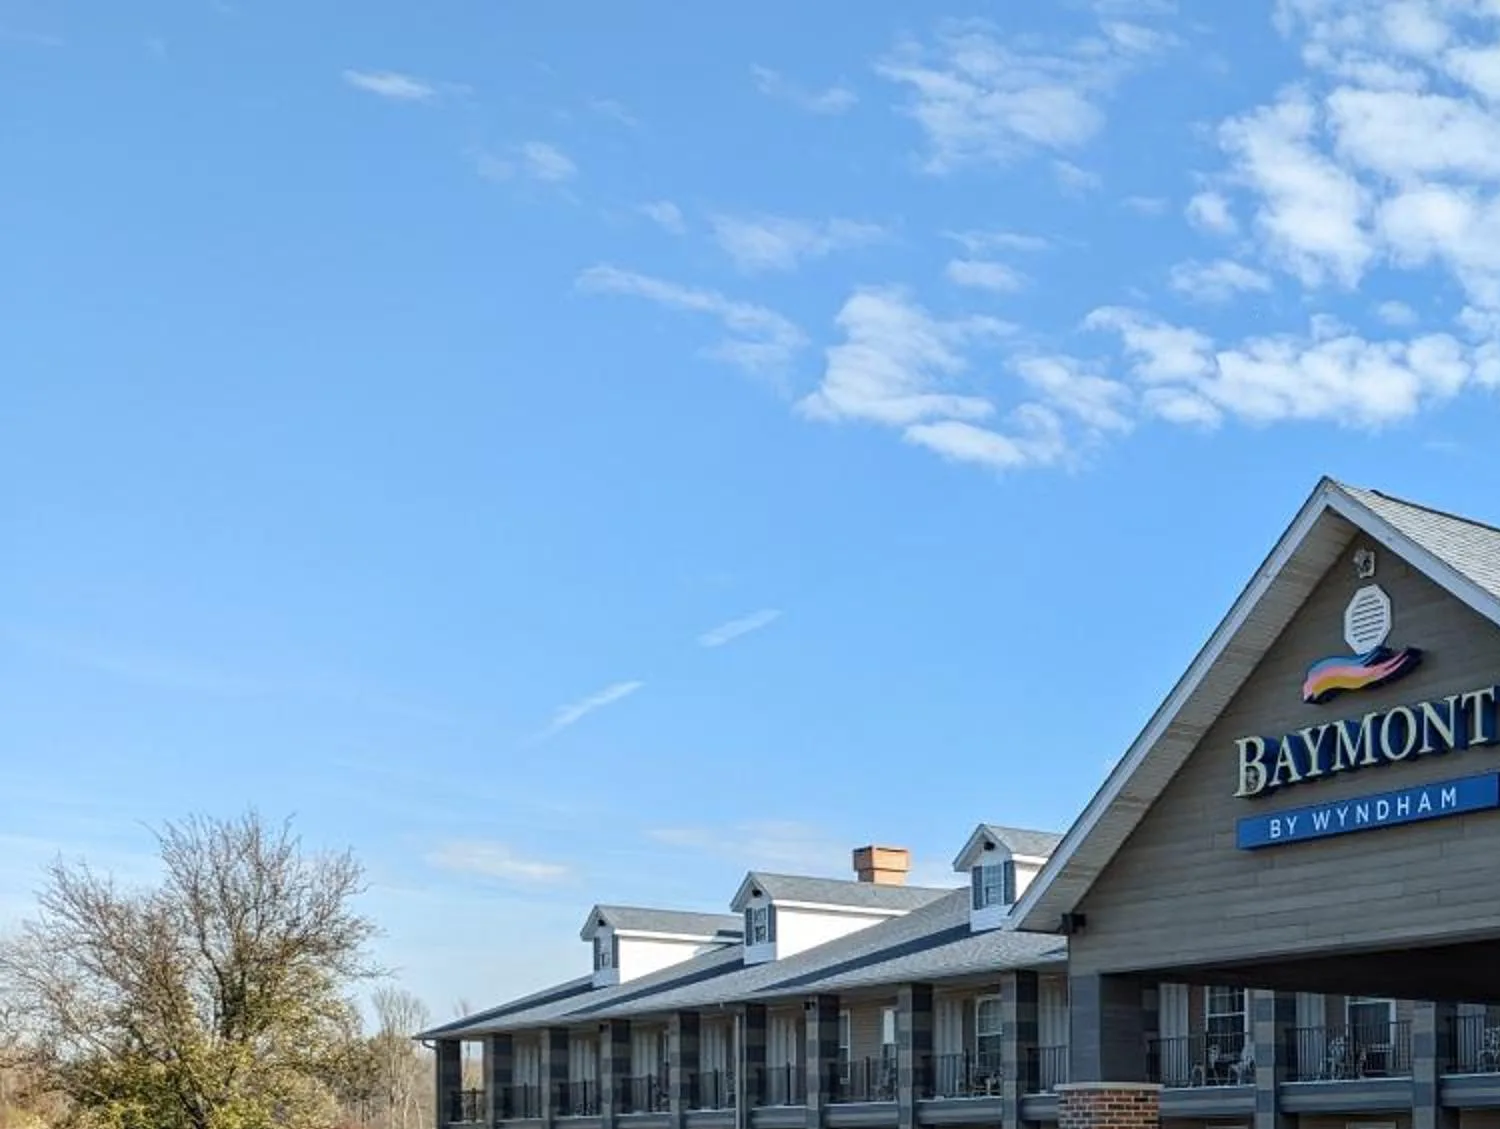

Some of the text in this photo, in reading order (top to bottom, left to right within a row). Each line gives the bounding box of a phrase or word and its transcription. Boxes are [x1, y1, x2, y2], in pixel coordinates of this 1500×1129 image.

[1233, 686, 1498, 798] BAYMONT
[1269, 786, 1457, 838] BY WYNDHAM
